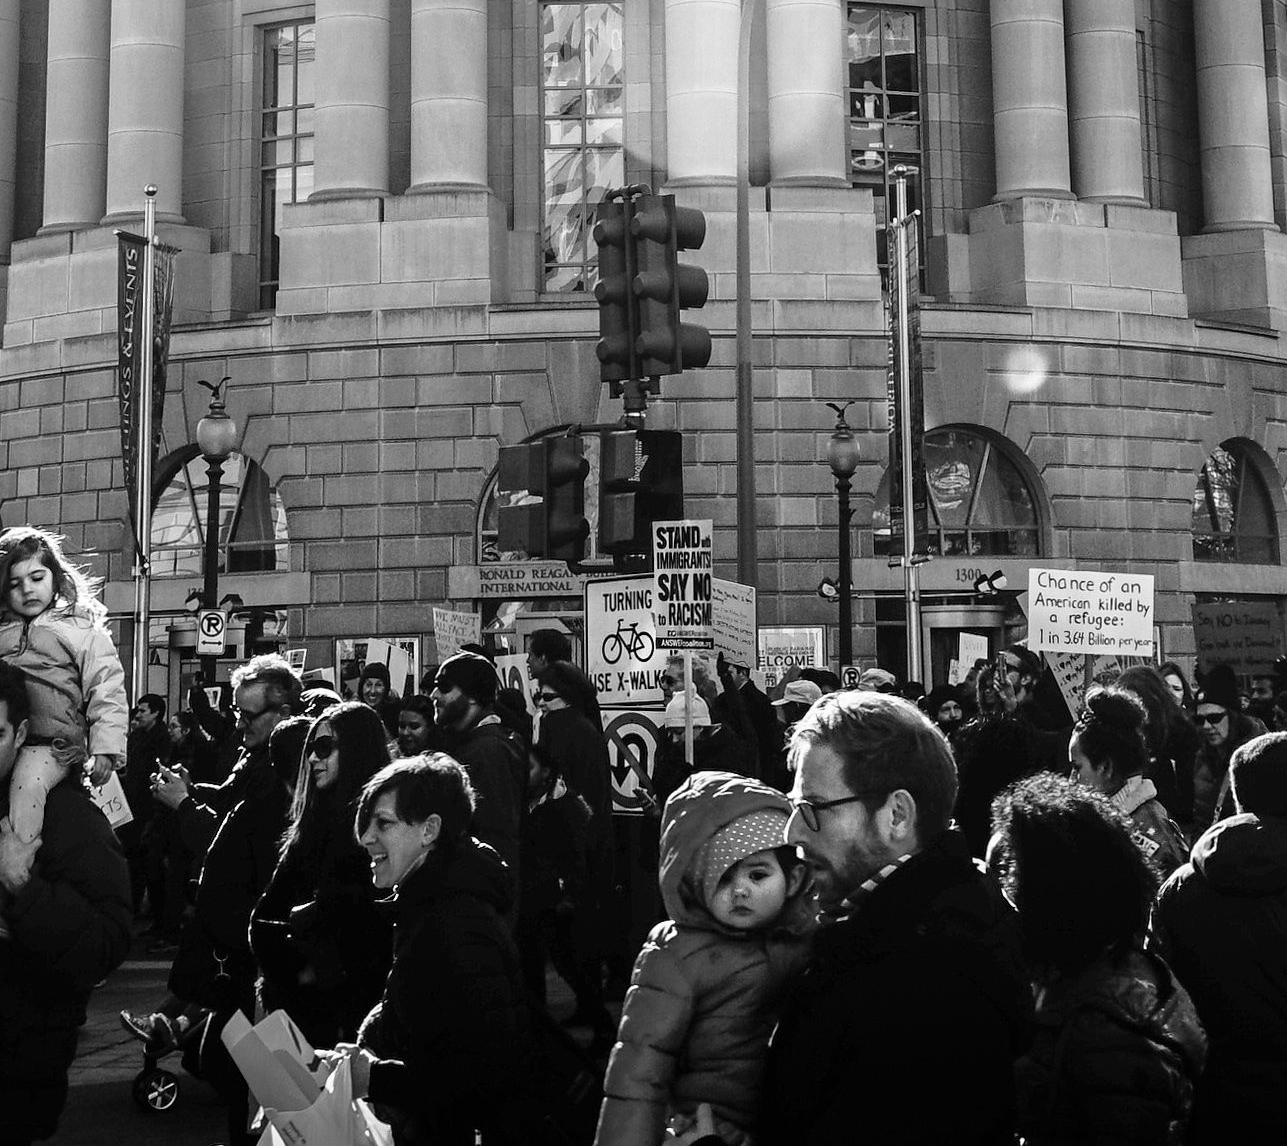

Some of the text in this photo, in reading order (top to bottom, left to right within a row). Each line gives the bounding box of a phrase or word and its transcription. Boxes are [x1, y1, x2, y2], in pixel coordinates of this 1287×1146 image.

[656, 525, 701, 549] STAND
[480, 568, 525, 580] RONALD
[955, 569, 981, 581] 1300
[1037, 571, 1141, 593] Chance of an
[480, 581, 573, 593] INTERNATIONAL
[657, 573, 689, 602] SAY
[693, 573, 712, 602] NO
[603, 590, 653, 612] TURNING
[1034, 592, 1150, 617] American killed by
[658, 603, 712, 626] to RACISM!
[1049, 612, 1125, 630] a refugee:
[1039, 629, 1153, 652] 1 in 3.64 Billion per year
[759, 655, 814, 666] ELCOME
[590, 669, 667, 693] USE X-WALK
